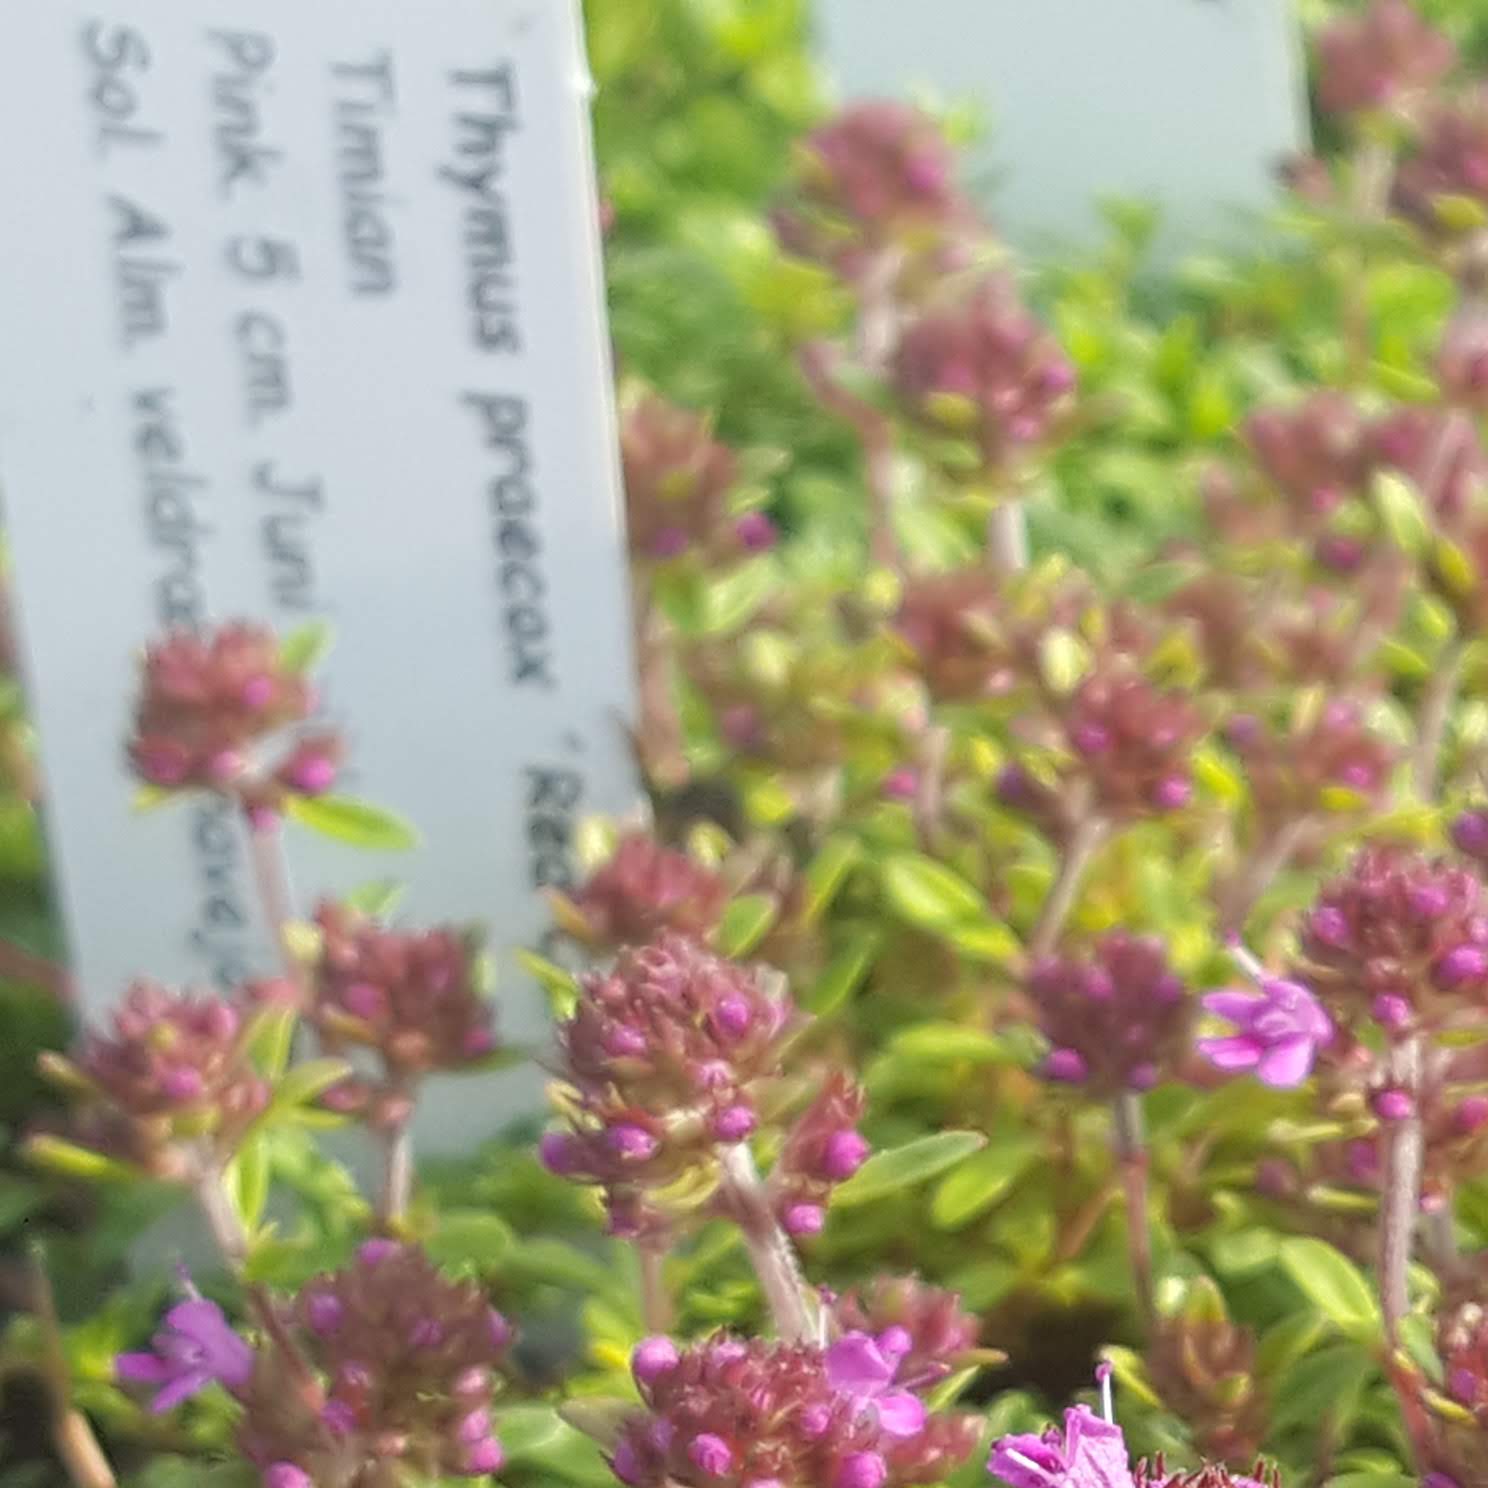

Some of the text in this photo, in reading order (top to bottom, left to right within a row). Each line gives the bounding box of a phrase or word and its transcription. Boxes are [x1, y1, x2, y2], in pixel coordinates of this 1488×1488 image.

[224, 234, 304, 285] 5
[330, 50, 402, 298] Timian
[436, 62, 522, 355] Thymus
[460, 389, 558, 692] praecox
